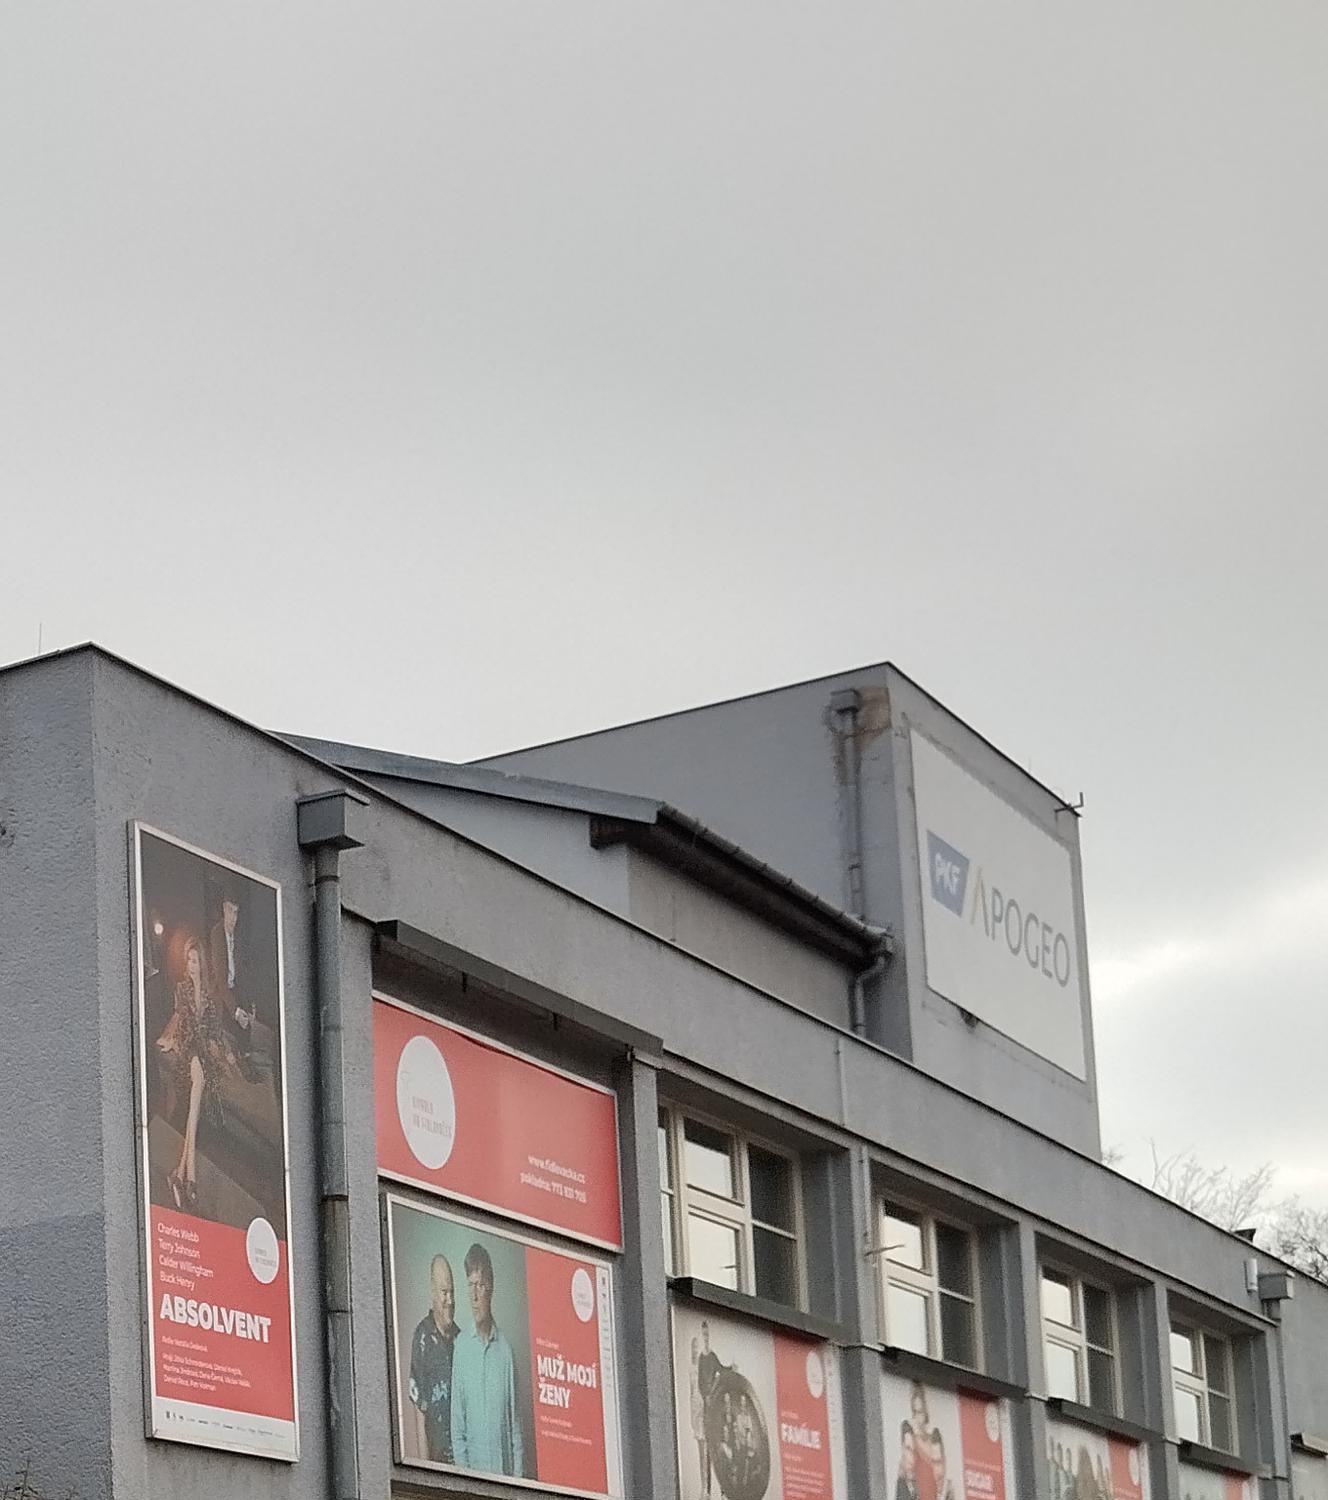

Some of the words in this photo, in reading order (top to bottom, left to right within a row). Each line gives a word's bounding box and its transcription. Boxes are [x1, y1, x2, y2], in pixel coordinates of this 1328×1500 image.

[971, 866, 1071, 988] APOGEO
[159, 1293, 272, 1343] ABSOLVENT
[536, 1354, 565, 1381] MUŽ
[566, 1361, 597, 1389] MOJÍ
[538, 1376, 572, 1409] ŽENY
